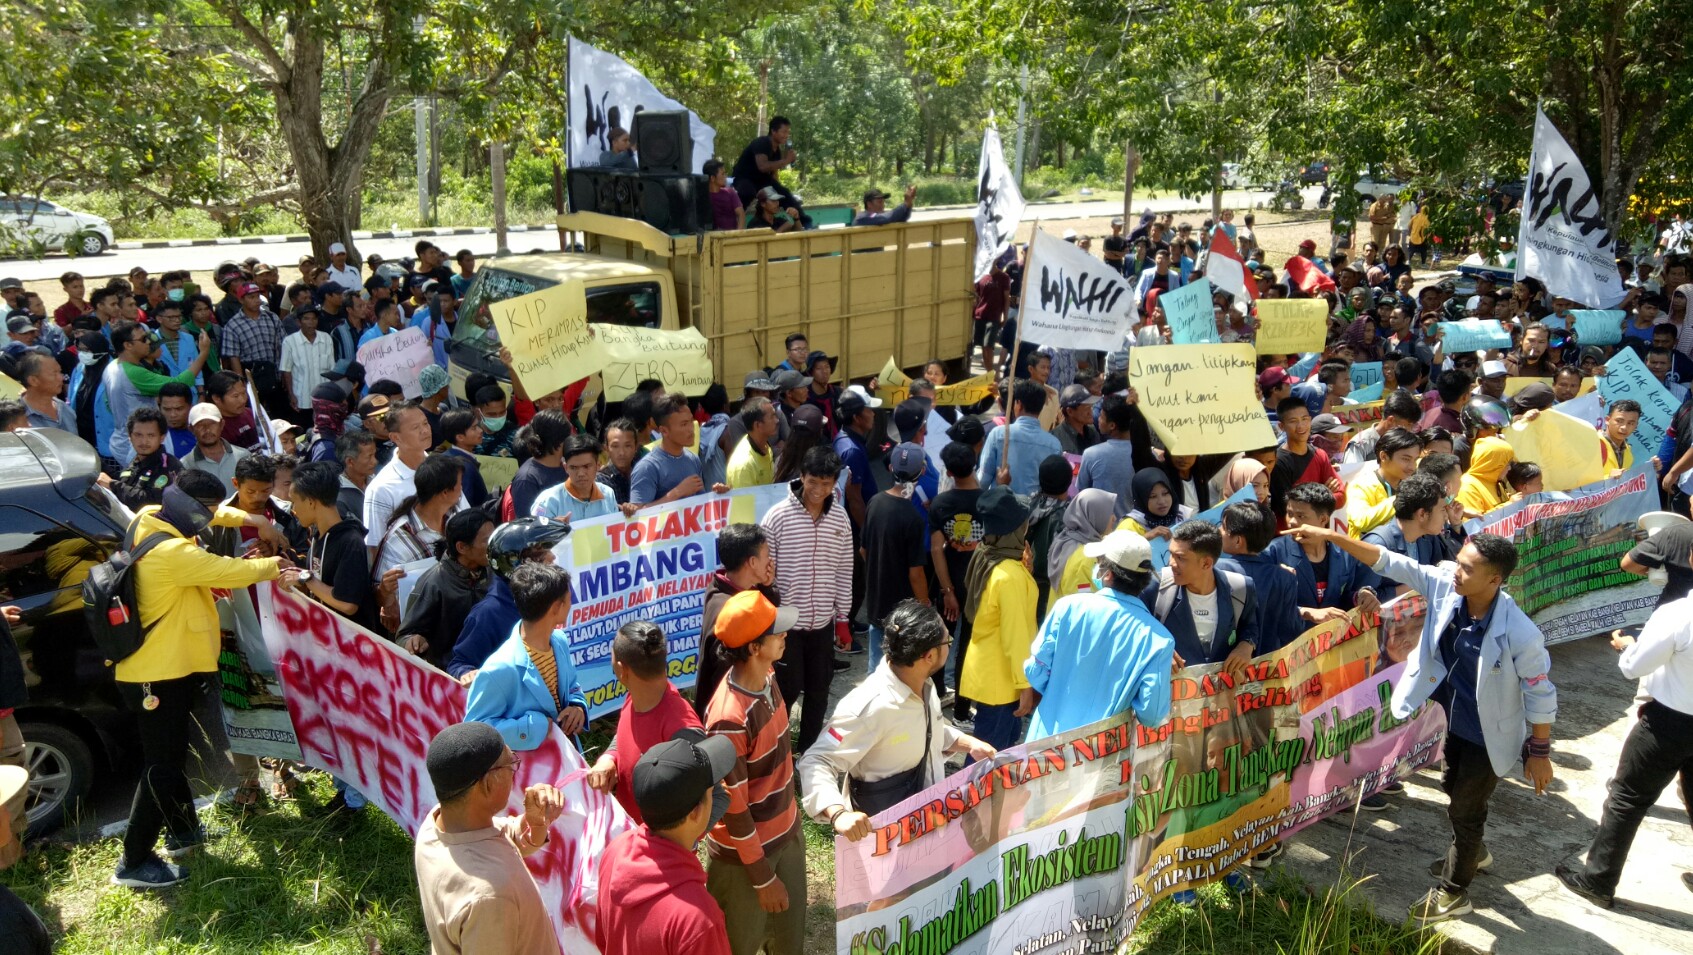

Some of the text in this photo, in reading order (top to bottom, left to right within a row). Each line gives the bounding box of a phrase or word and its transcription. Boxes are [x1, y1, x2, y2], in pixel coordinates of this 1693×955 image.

[1041, 265, 1125, 319] WALHI
[505, 299, 547, 334] KIP
[642, 343, 707, 357] Belitung
[607, 360, 678, 390] ZERO
[606, 498, 731, 553] TOLAK!!!
[569, 541, 704, 606] AMBANG
[1590, 559, 1618, 574] PESISIR
[572, 596, 624, 627] PEMUDA
[627, 588, 654, 608] DAN
[670, 592, 705, 609] PANT
[582, 680, 629, 710] TOLA
[1136, 706, 1230, 748] Bangka
[872, 744, 1066, 857] PERSATUAN
[1170, 671, 1235, 702] DAN
[1000, 827, 1120, 914] Ekosistem
[1160, 759, 1220, 814] Zona
[1223, 728, 1306, 799] Tangkap
